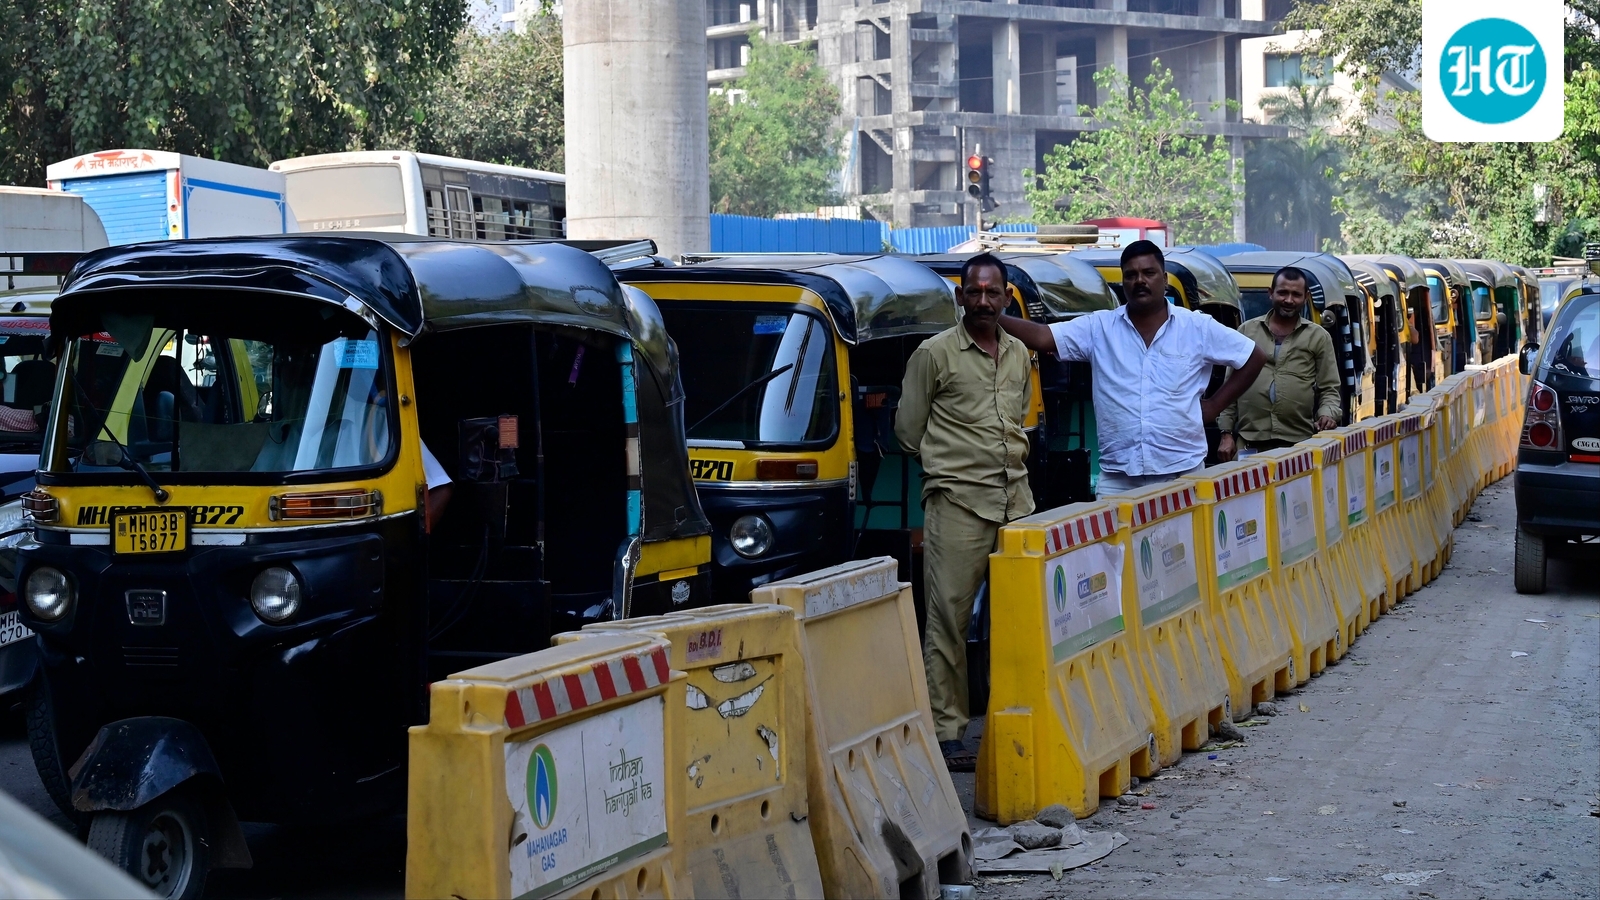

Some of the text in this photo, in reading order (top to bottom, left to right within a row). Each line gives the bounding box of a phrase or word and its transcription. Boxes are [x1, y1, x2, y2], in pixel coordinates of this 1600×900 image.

[88, 159, 104, 169] जय
[313, 219, 360, 230] EICHER
[1565, 396, 1600, 404] SANTRO
[129, 513, 178, 533] MH03B
[130, 532, 178, 551] T5877
[609, 748, 643, 783] indhan
[603, 775, 653, 818] hariyali ka
[526, 828, 568, 859] MAHANAGAR
[541, 852, 556, 872] GAS
